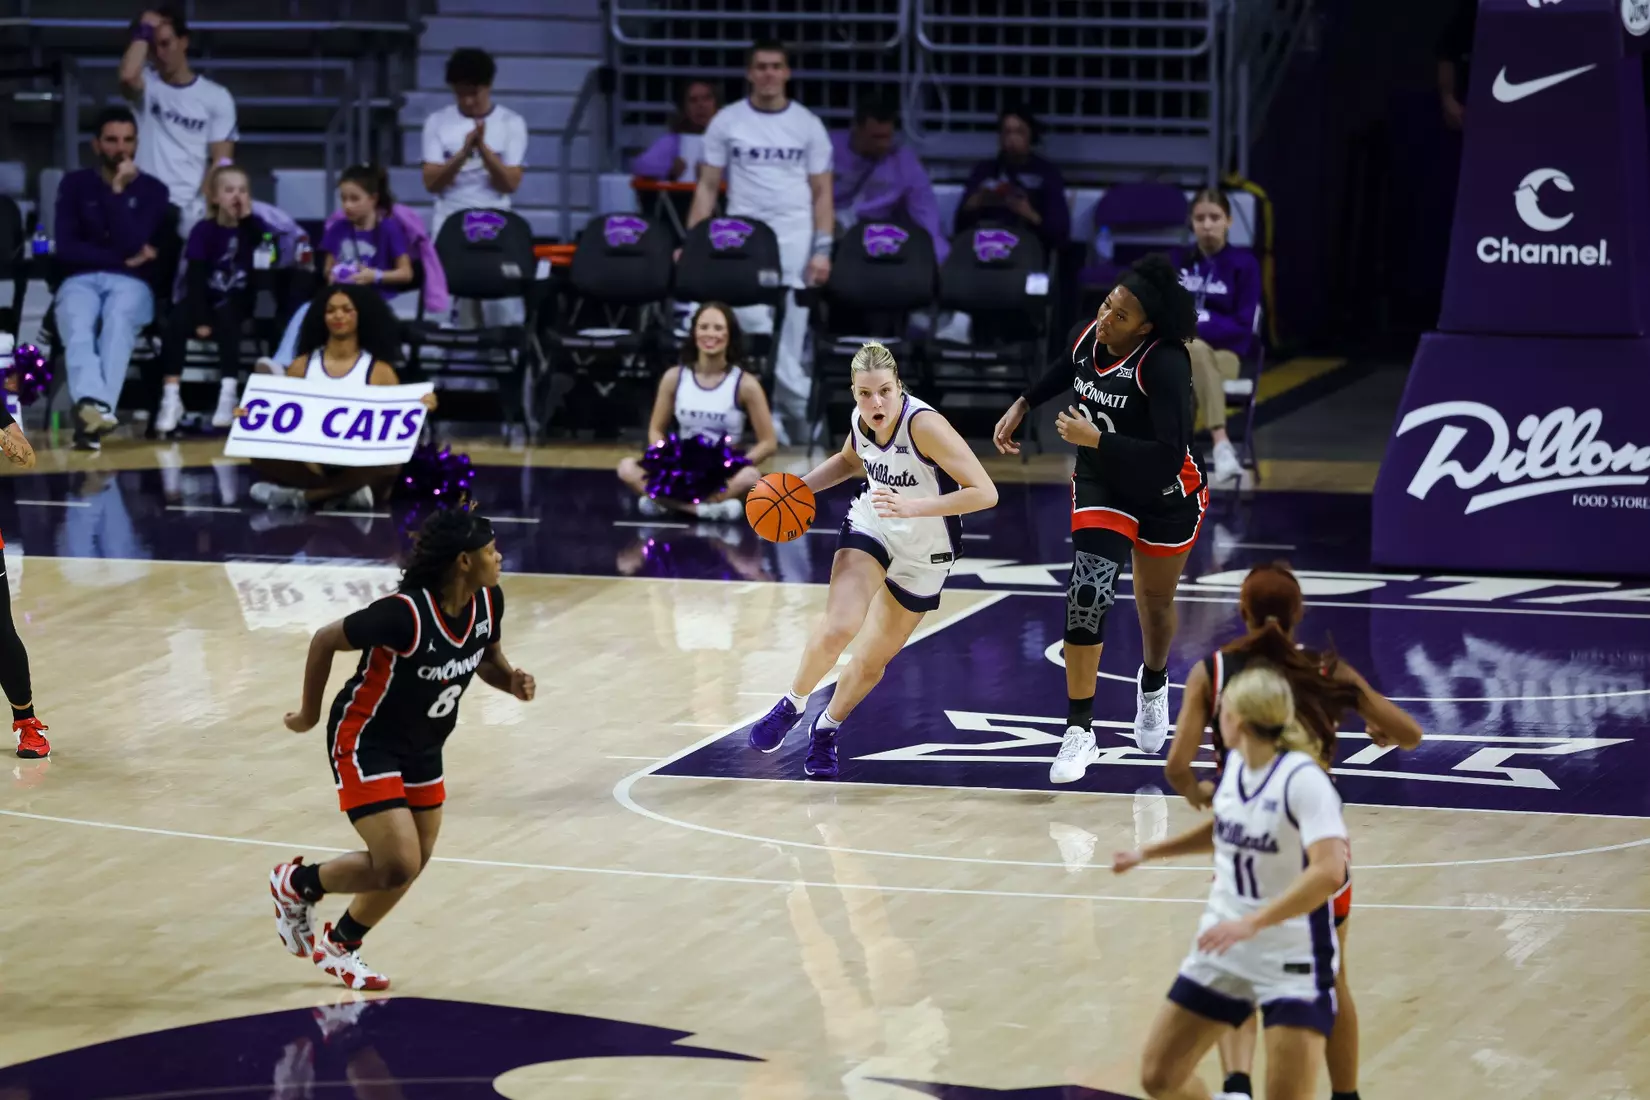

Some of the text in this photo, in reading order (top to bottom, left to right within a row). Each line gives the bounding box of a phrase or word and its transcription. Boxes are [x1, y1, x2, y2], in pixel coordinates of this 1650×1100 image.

[1073, 376, 1129, 409] CINCINNATI
[239, 398, 422, 441] GO CATS
[863, 459, 919, 487] Wildcats
[1572, 494, 1608, 508] FOOD
[427, 684, 462, 718] 8
[1233, 852, 1262, 899] 11
